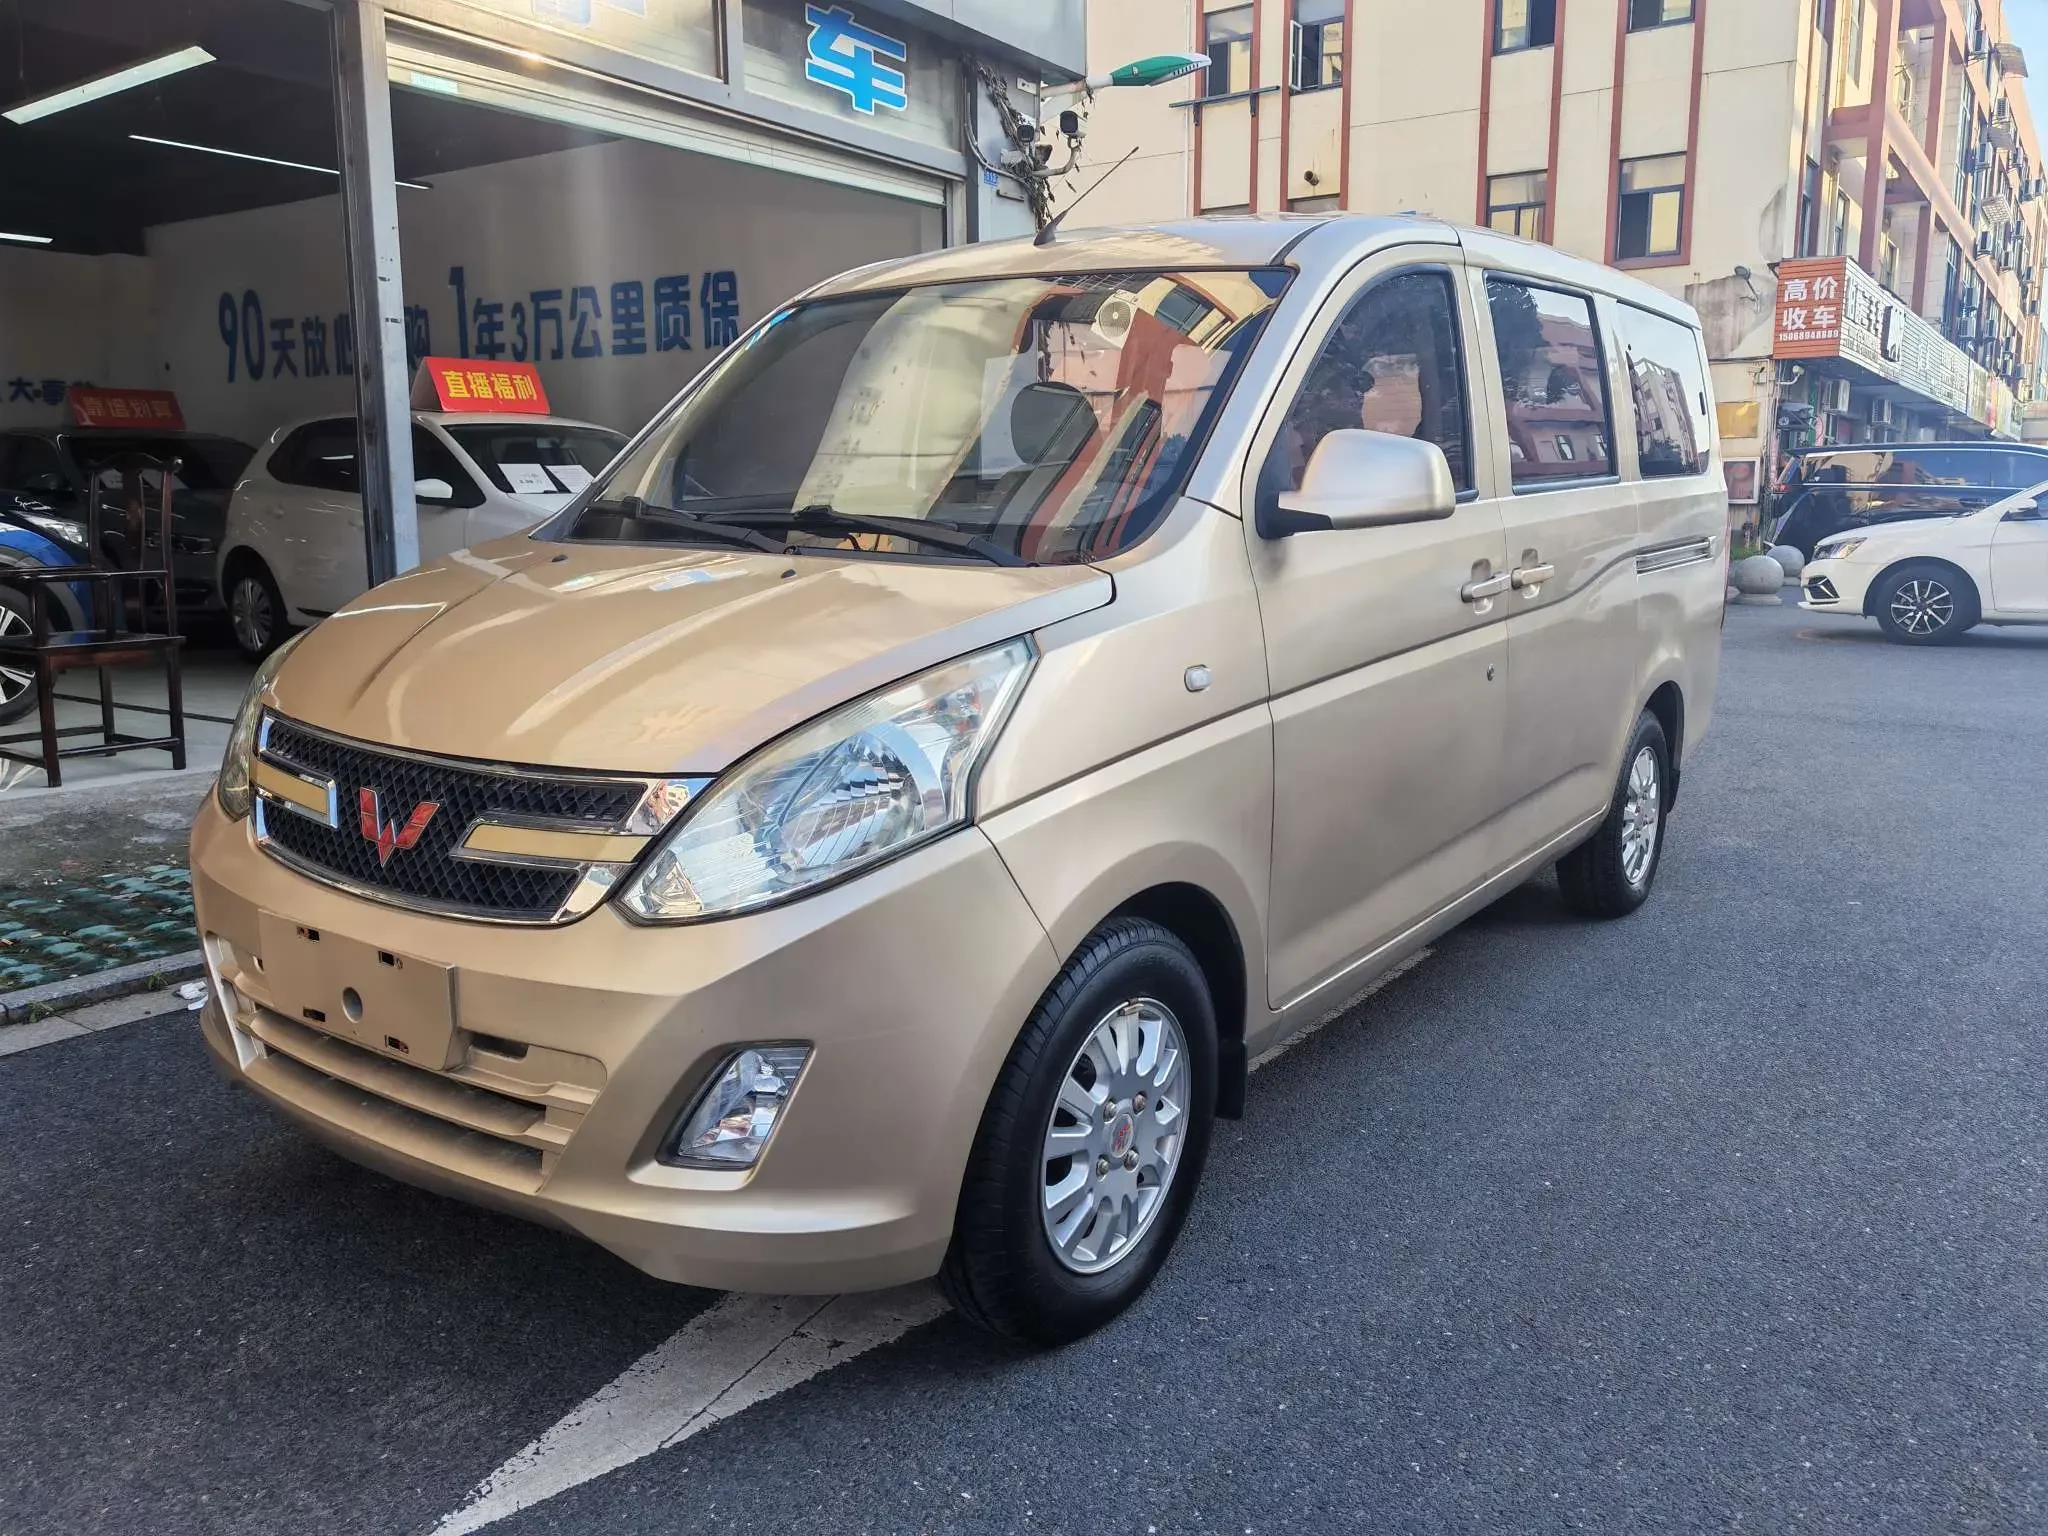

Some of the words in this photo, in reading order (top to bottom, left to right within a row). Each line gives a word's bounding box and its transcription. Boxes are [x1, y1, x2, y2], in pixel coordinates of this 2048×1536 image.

[805, 3, 907, 115] 车
[1784, 276, 1838, 302] 高价
[448, 266, 740, 362] 1年3万公里质保
[1782, 305, 1837, 330] 收车
[441, 370, 537, 401] 直播福利
